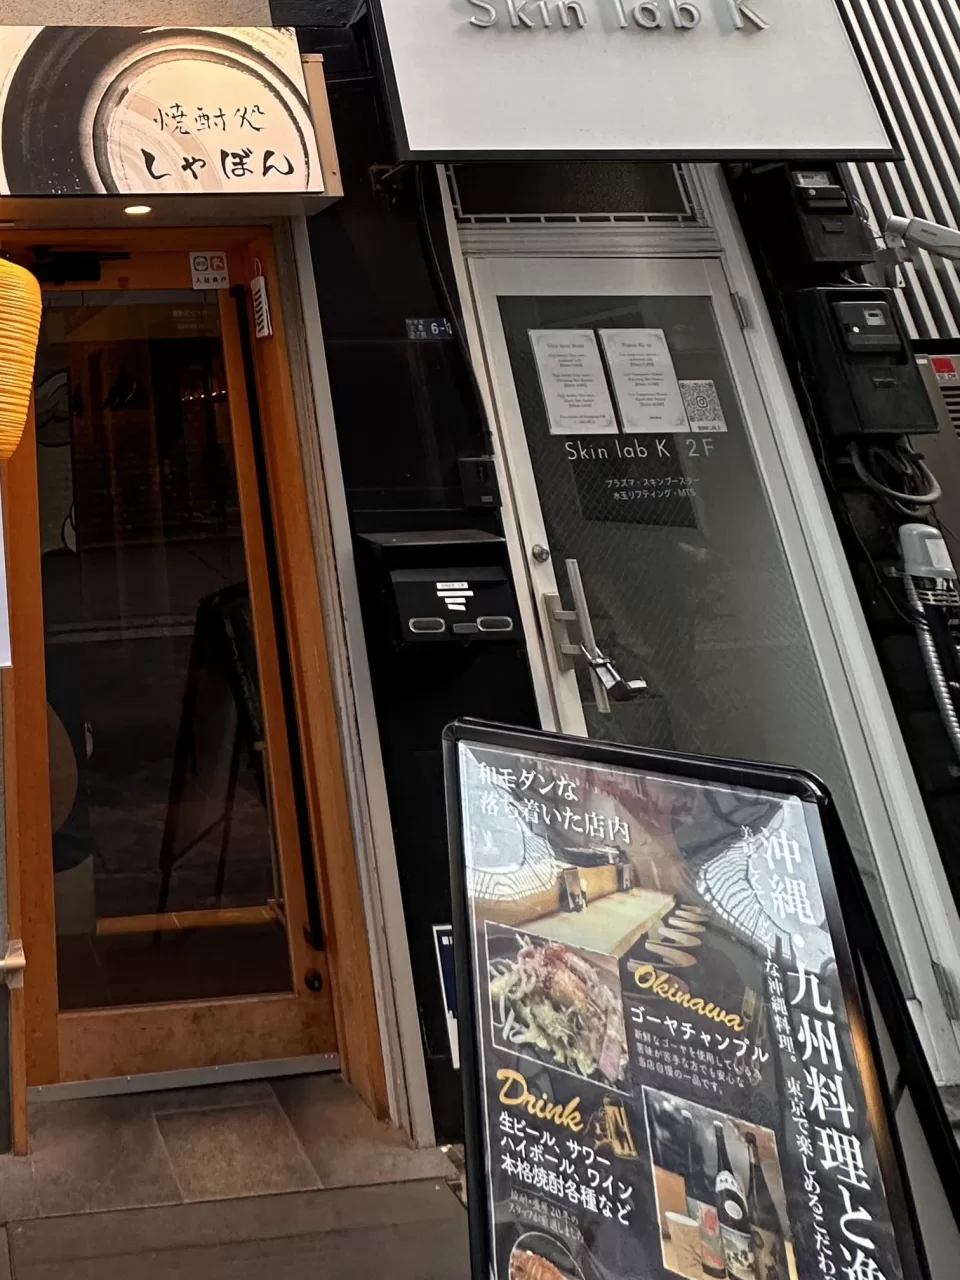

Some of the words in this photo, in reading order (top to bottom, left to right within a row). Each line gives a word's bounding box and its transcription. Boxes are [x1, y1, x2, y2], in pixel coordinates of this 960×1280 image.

[152, 102, 267, 135] 焼酎処
[140, 147, 296, 180] しゃぼん
[565, 441, 609, 461] Skin
[616, 439, 648, 458] lab
[656, 439, 671, 458] K
[686, 438, 715, 457] 2F
[477, 761, 579, 802] 和モダンな
[479, 789, 631, 844] 落ち着いた店内
[634, 964, 745, 1032] Okinawa
[630, 1006, 769, 1063] ゴーヤチャンプル
[496, 1068, 585, 1132] Drink
[499, 1111, 611, 1166] 生ビール、サワー
[500, 1136, 633, 1200] ハイボール、ワイン
[500, 1153, 632, 1226] 本格焼酎各種など
